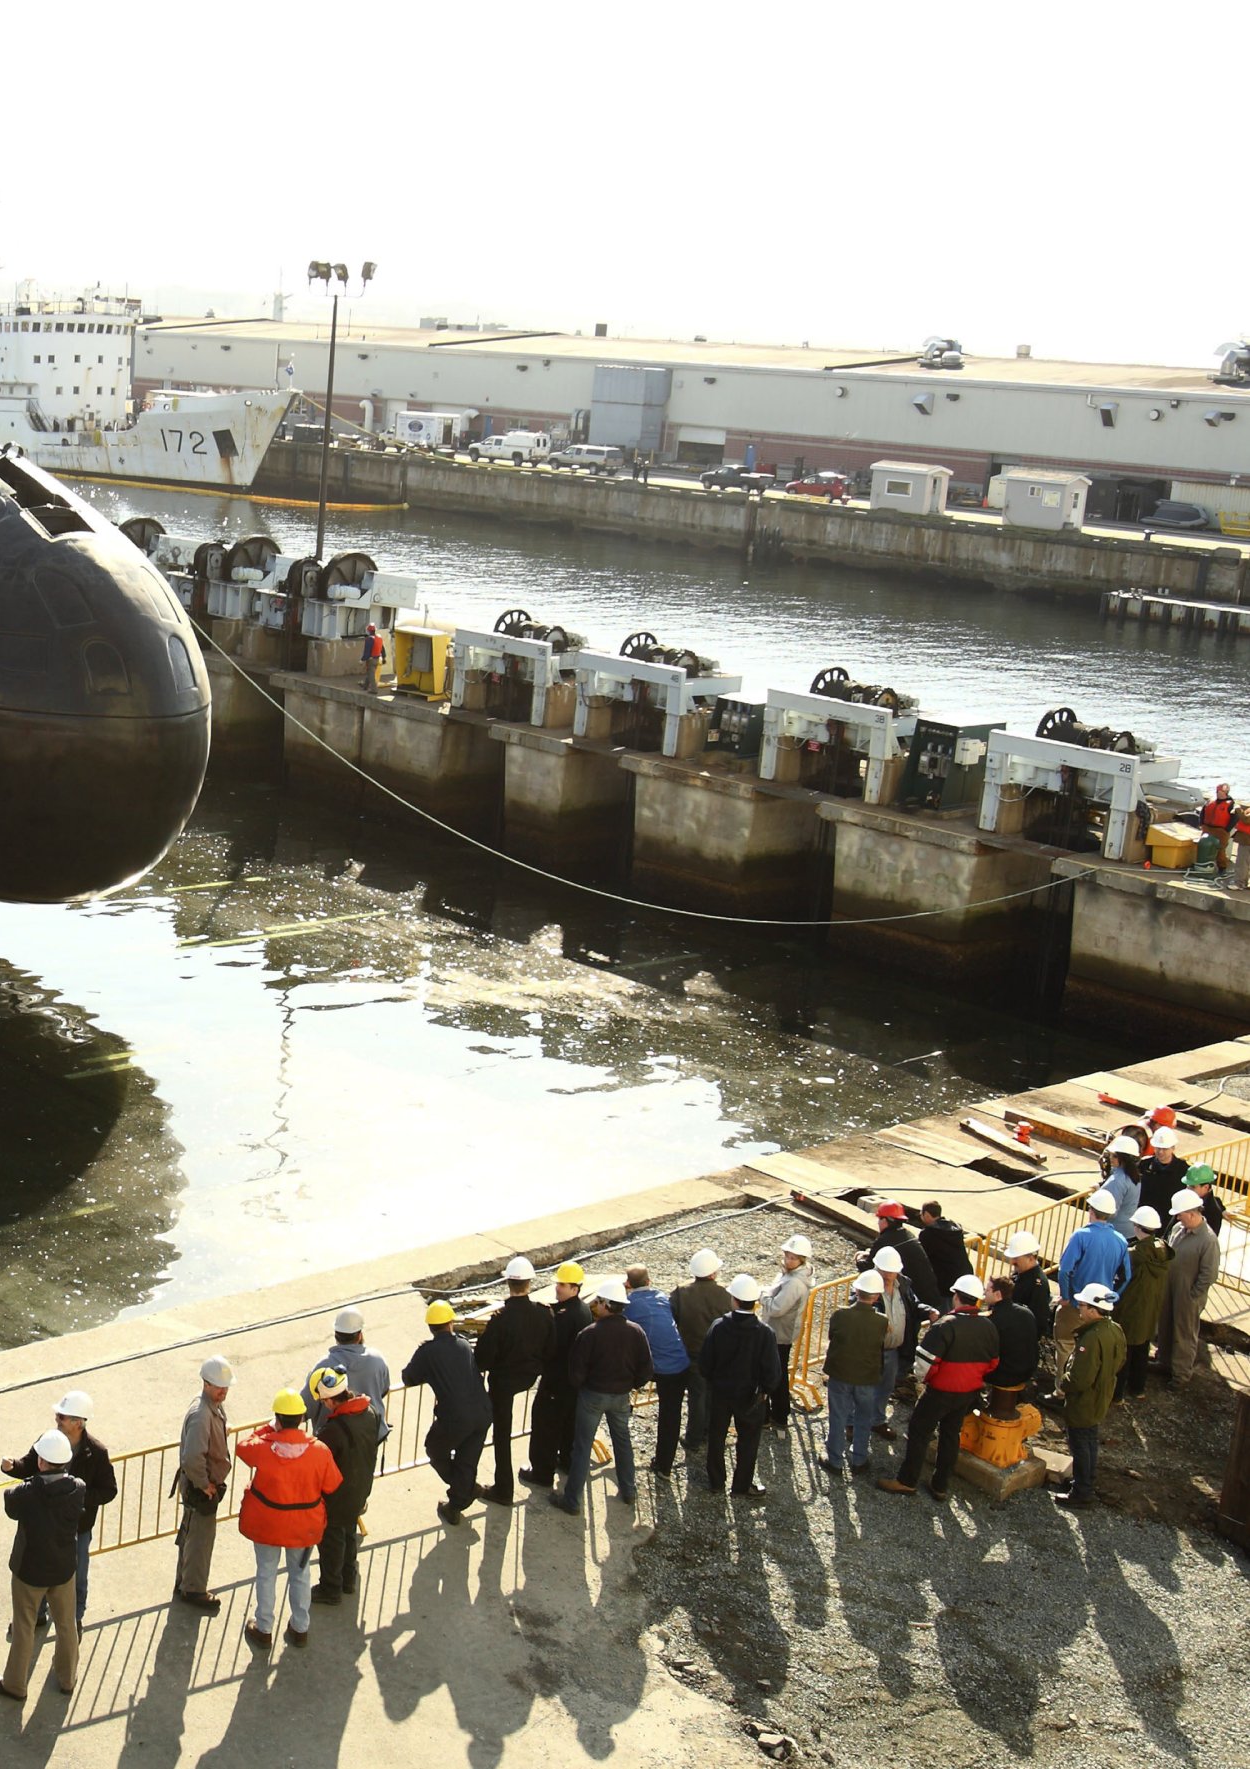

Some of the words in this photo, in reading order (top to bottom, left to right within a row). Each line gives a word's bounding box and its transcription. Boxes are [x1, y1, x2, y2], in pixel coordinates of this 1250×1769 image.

[160, 428, 208, 455] 172
[874, 714, 885, 724] 3B
[1119, 762, 1132, 773] 2B
